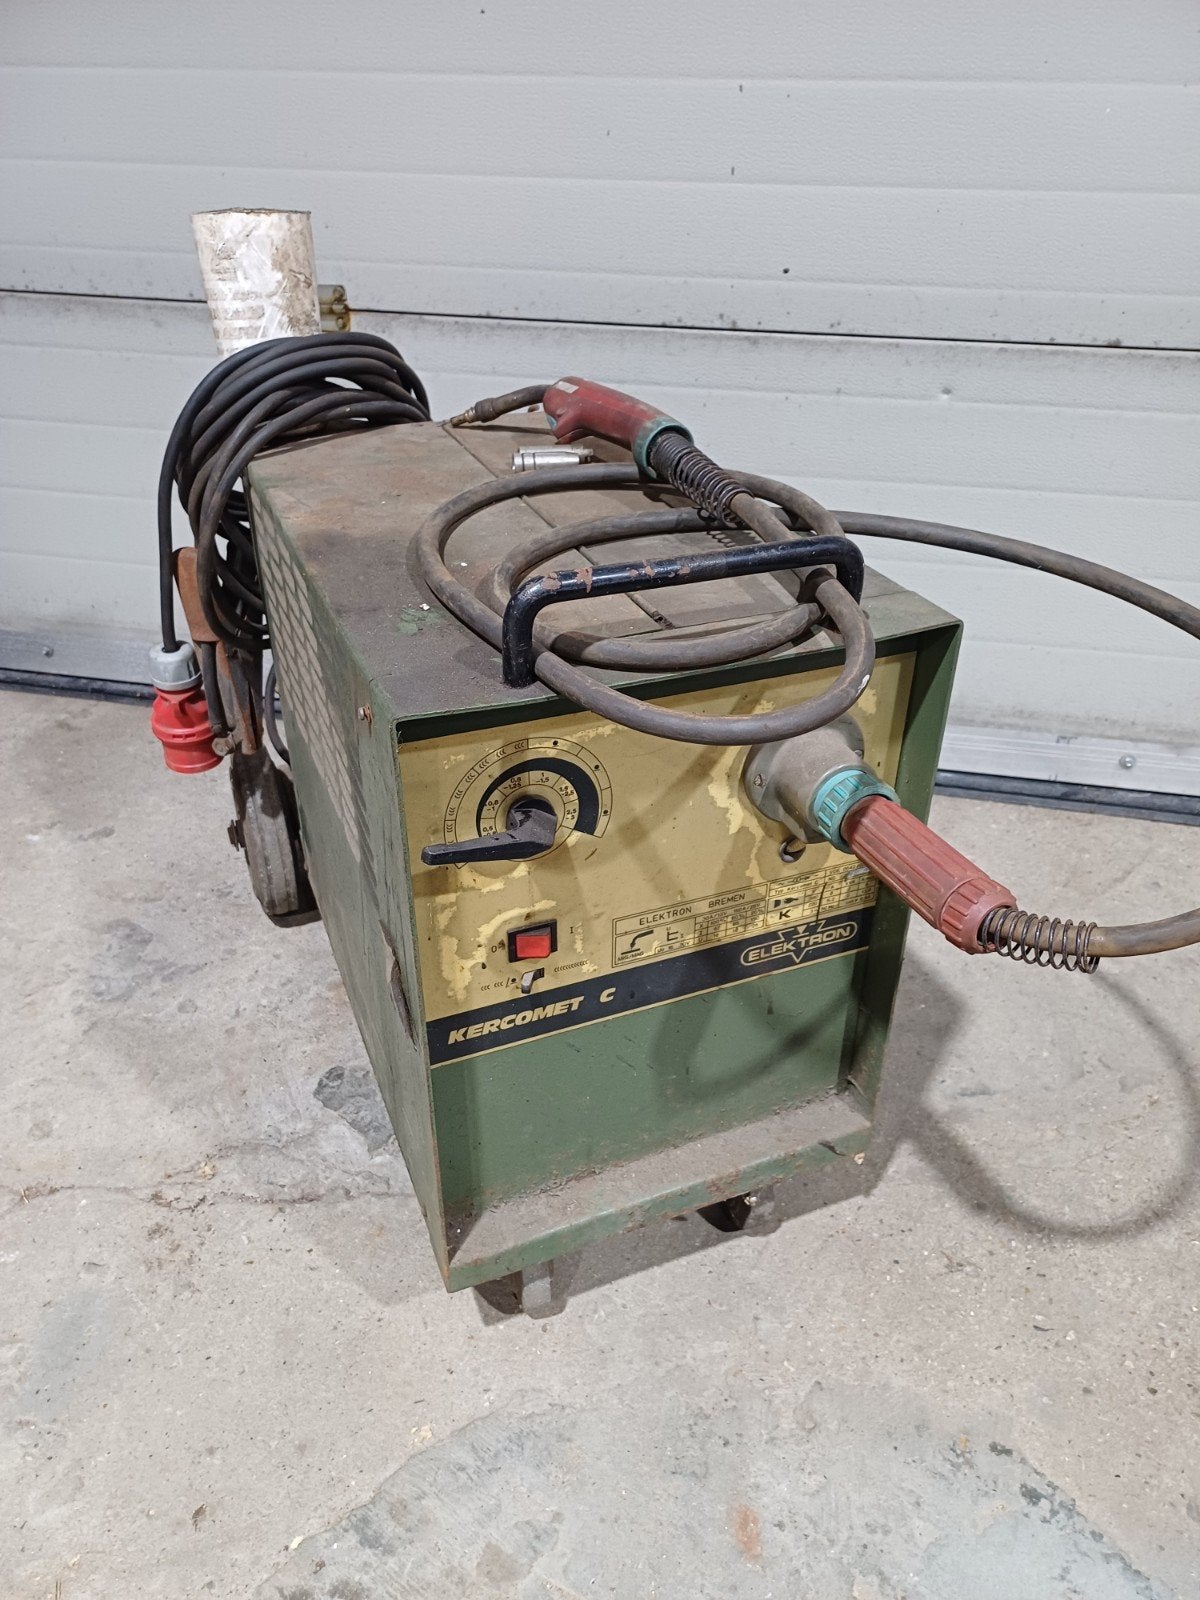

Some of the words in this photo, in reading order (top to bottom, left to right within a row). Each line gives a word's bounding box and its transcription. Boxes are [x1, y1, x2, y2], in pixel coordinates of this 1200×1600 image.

[639, 906, 692, 926] ELEKTRON
[708, 893, 746, 908] BREMEN
[779, 909, 791, 920] K
[748, 926, 851, 961] ELEKTRON
[448, 996, 585, 1045] KERCOMET
[600, 987, 616, 1003] C
